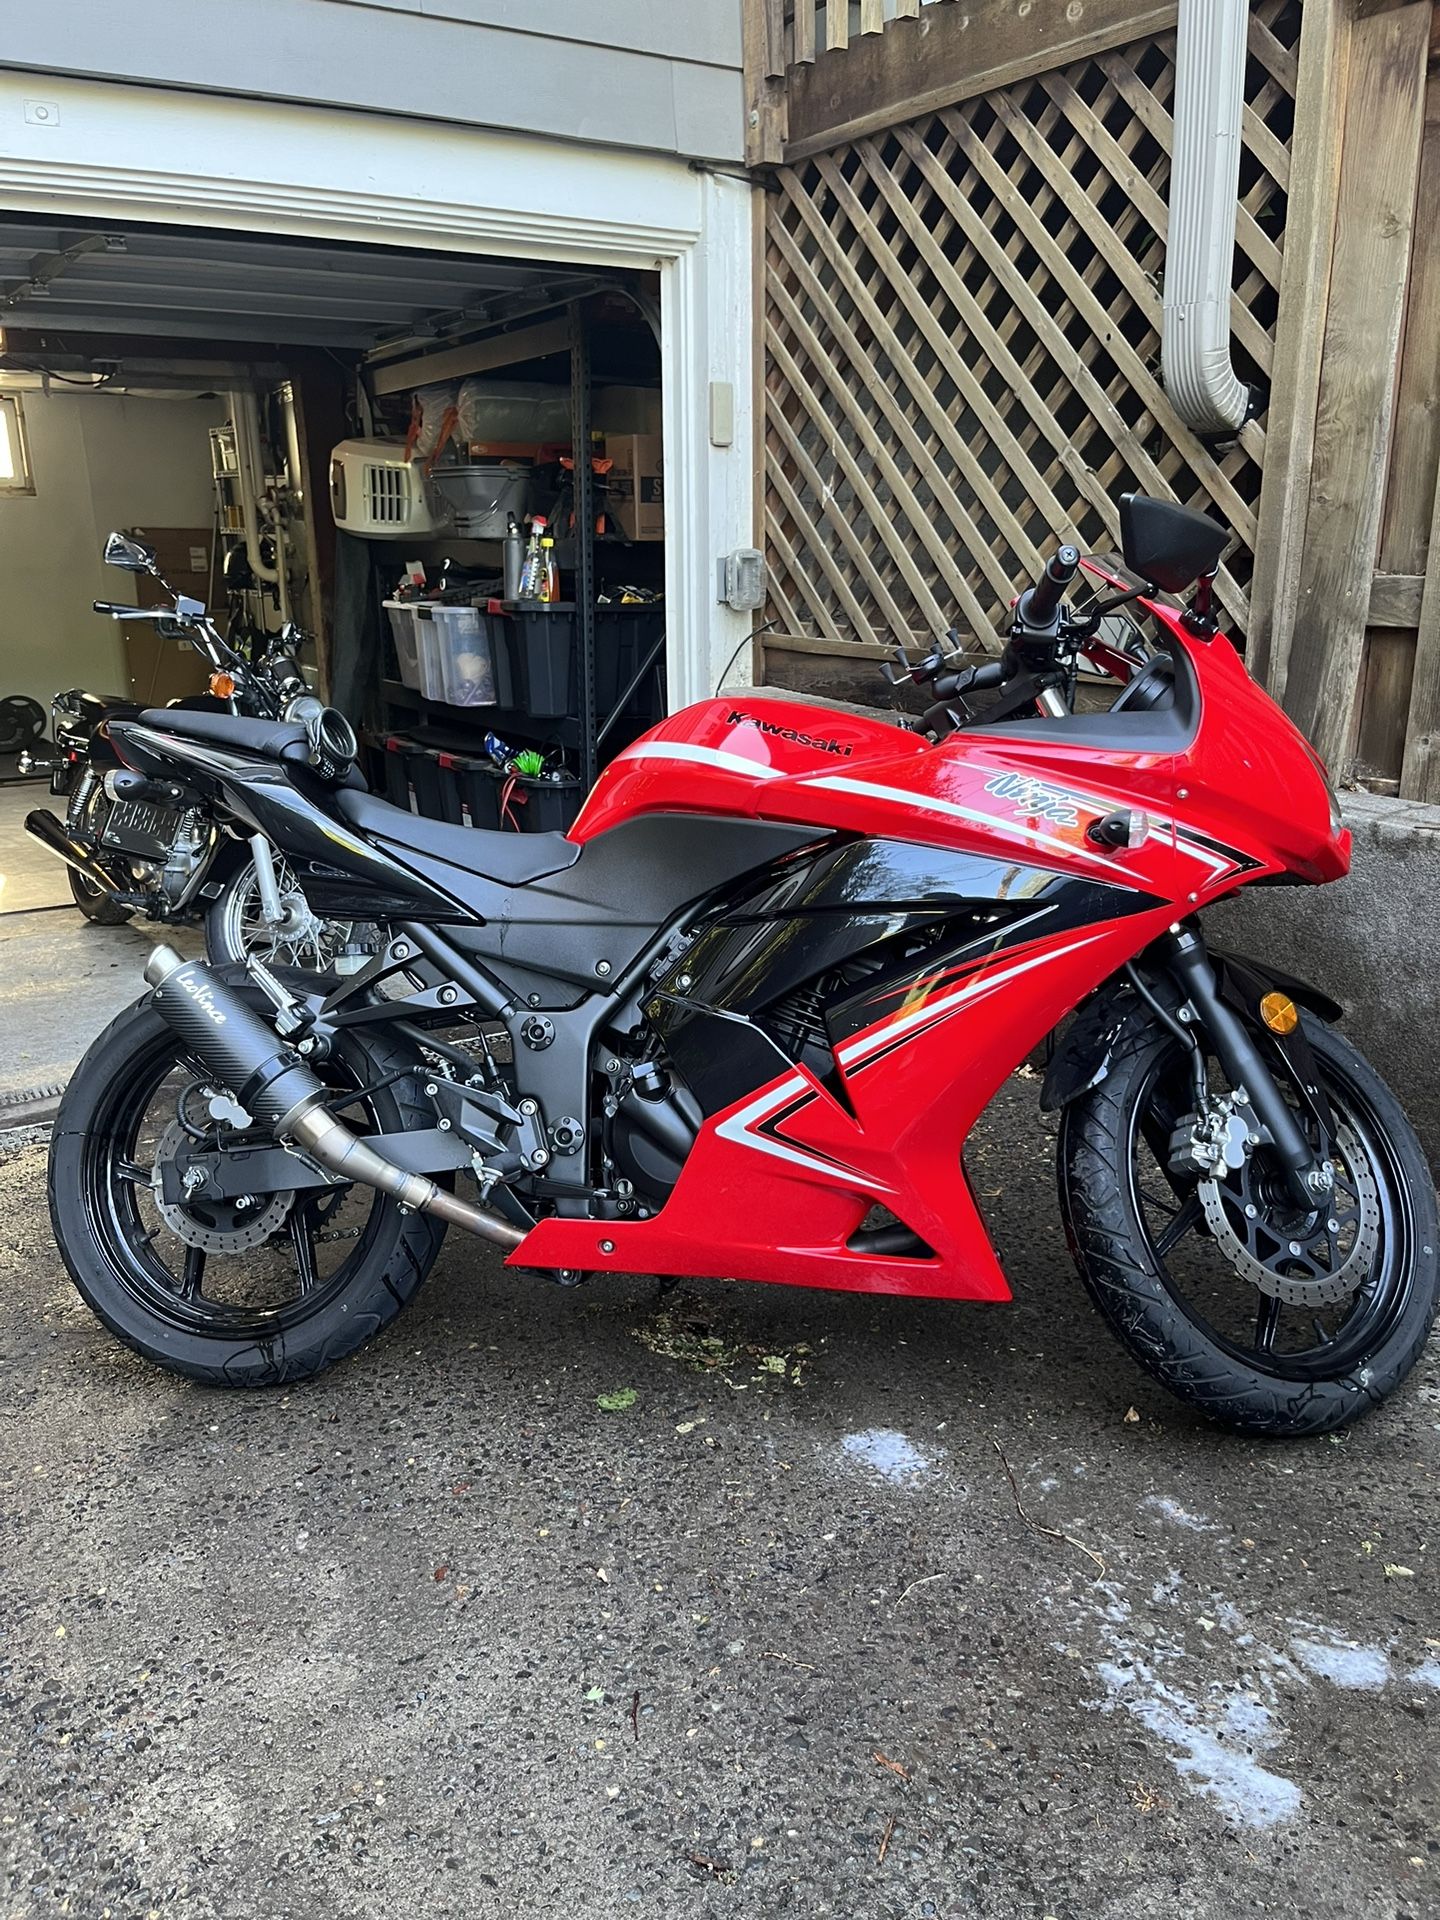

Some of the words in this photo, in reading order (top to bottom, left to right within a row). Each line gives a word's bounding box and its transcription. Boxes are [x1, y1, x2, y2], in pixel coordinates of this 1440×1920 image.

[727, 710, 854, 757] Kawasaki
[985, 773, 1078, 827] Ninja
[176, 970, 226, 1024] LeoVince
